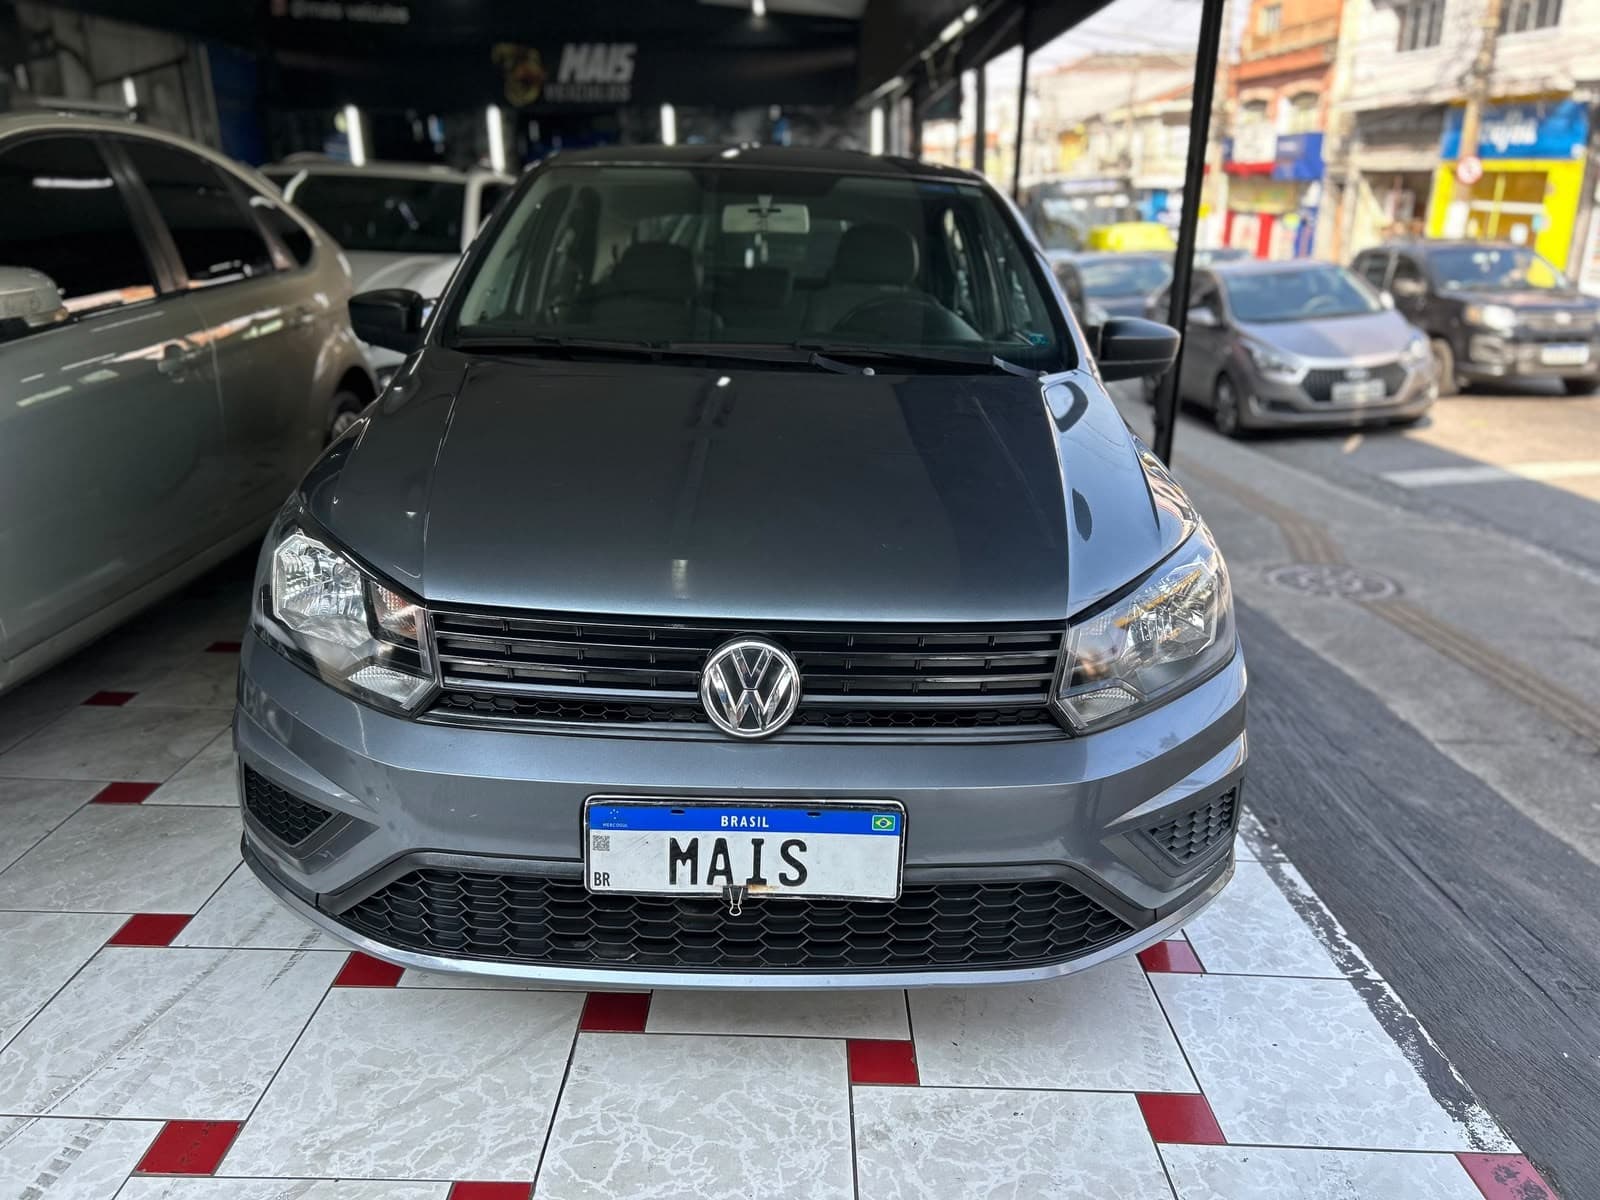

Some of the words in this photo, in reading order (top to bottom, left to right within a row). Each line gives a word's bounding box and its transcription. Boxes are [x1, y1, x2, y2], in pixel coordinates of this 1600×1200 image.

[557, 43, 637, 83] MAIS
[720, 815, 770, 829] BRASIL
[668, 837, 808, 887] MAIS
[593, 872, 611, 887] BR
